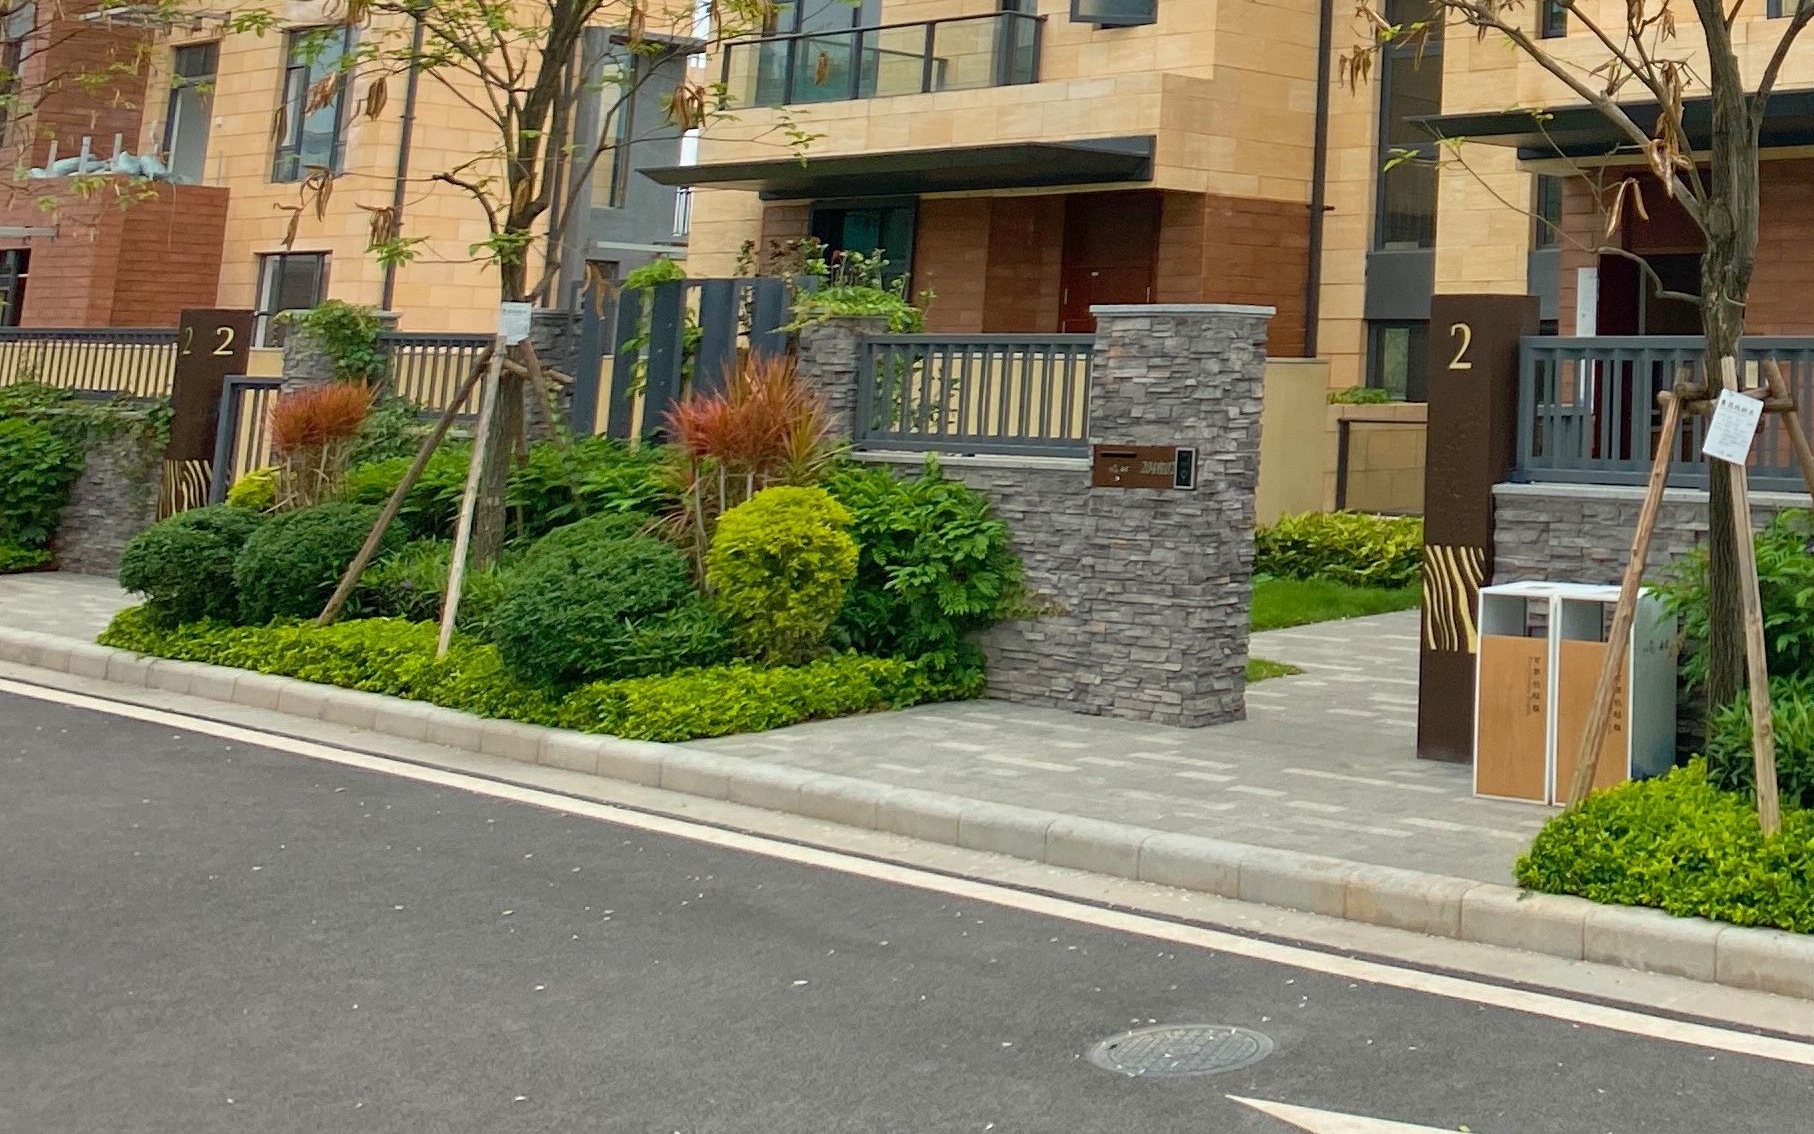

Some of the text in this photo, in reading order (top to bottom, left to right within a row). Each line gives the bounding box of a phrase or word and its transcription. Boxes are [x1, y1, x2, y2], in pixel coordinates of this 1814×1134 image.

[182, 326, 193, 355] 2
[213, 326, 235, 355] 2
[1449, 323, 1472, 369] 2
